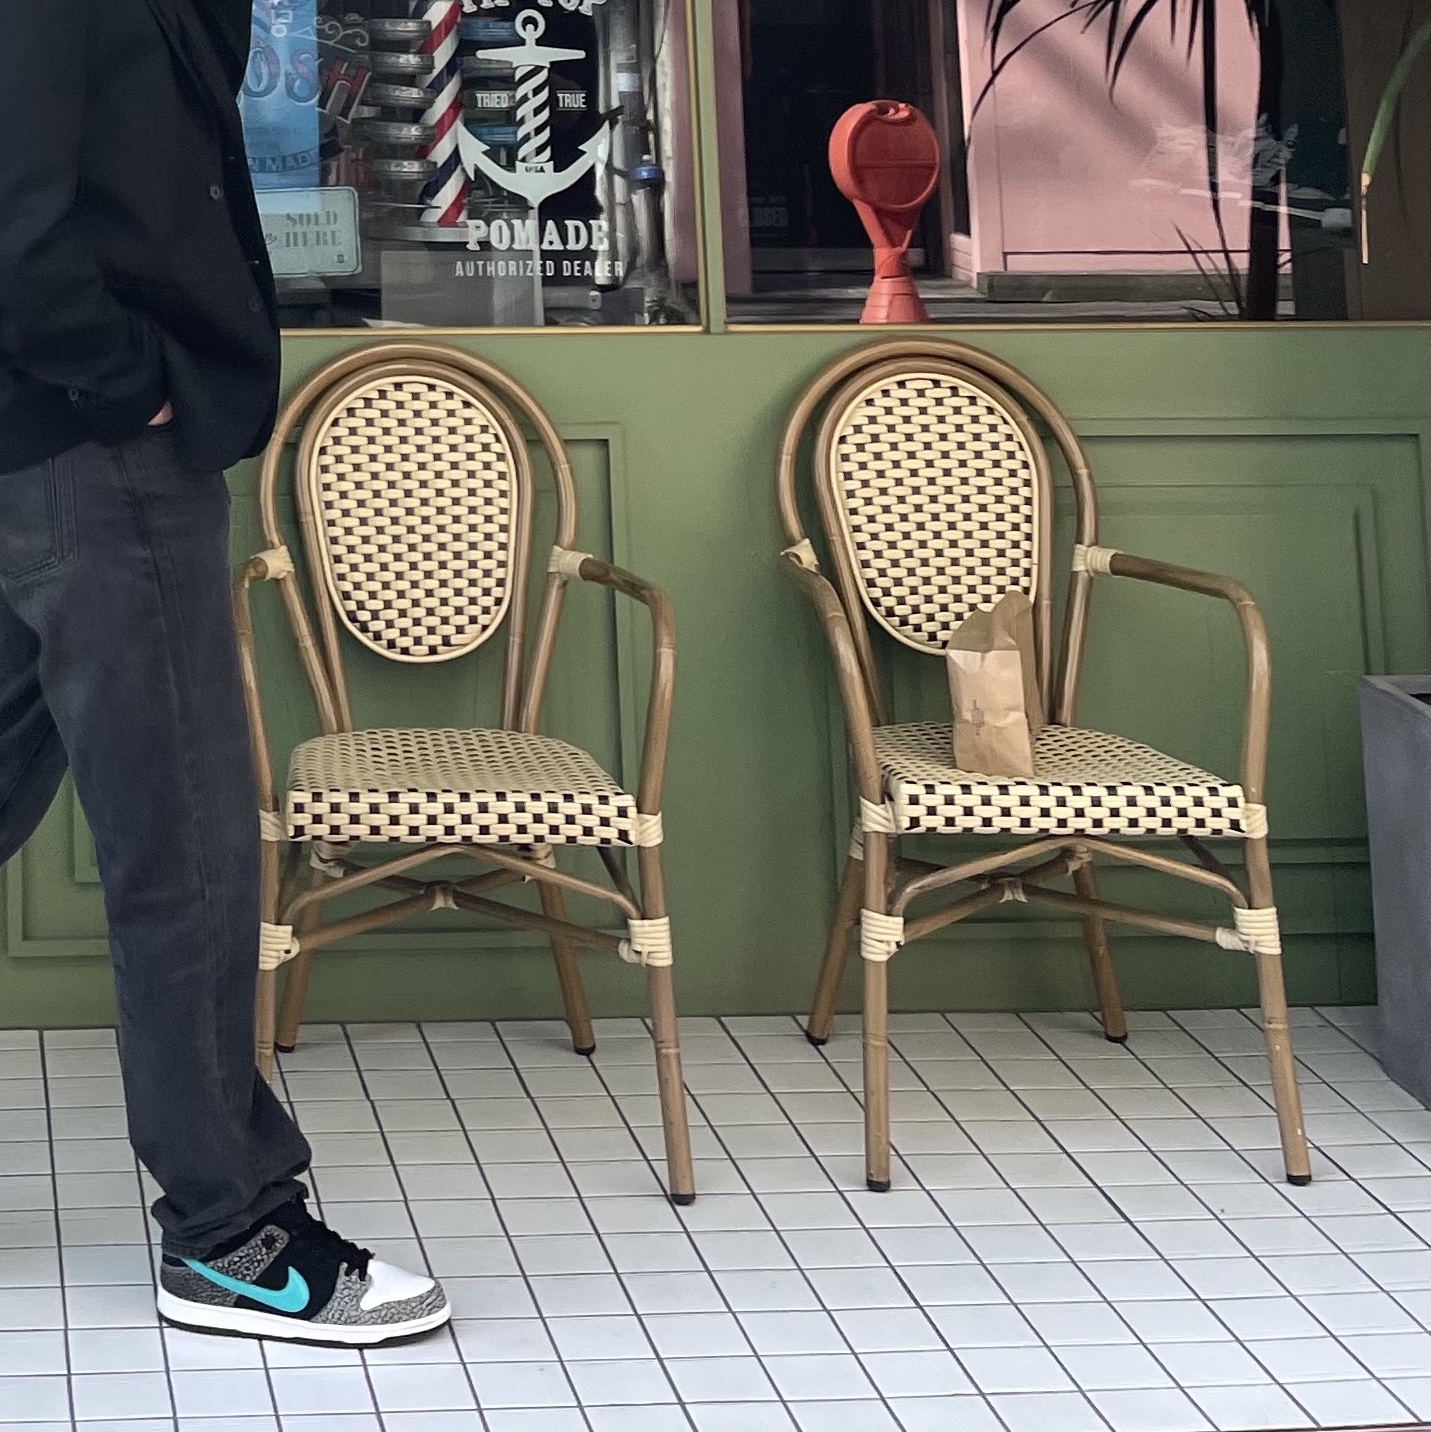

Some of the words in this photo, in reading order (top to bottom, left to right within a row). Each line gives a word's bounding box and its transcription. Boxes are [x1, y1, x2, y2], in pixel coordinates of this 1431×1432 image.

[476, 91, 510, 108] TRIED
[557, 92, 588, 108] TRUE
[285, 210, 338, 228] SOLD
[284, 229, 343, 248] HERE
[464, 219, 610, 251] POMADE
[454, 260, 555, 278] AUTHORIZED
[562, 260, 625, 278] DEALER
